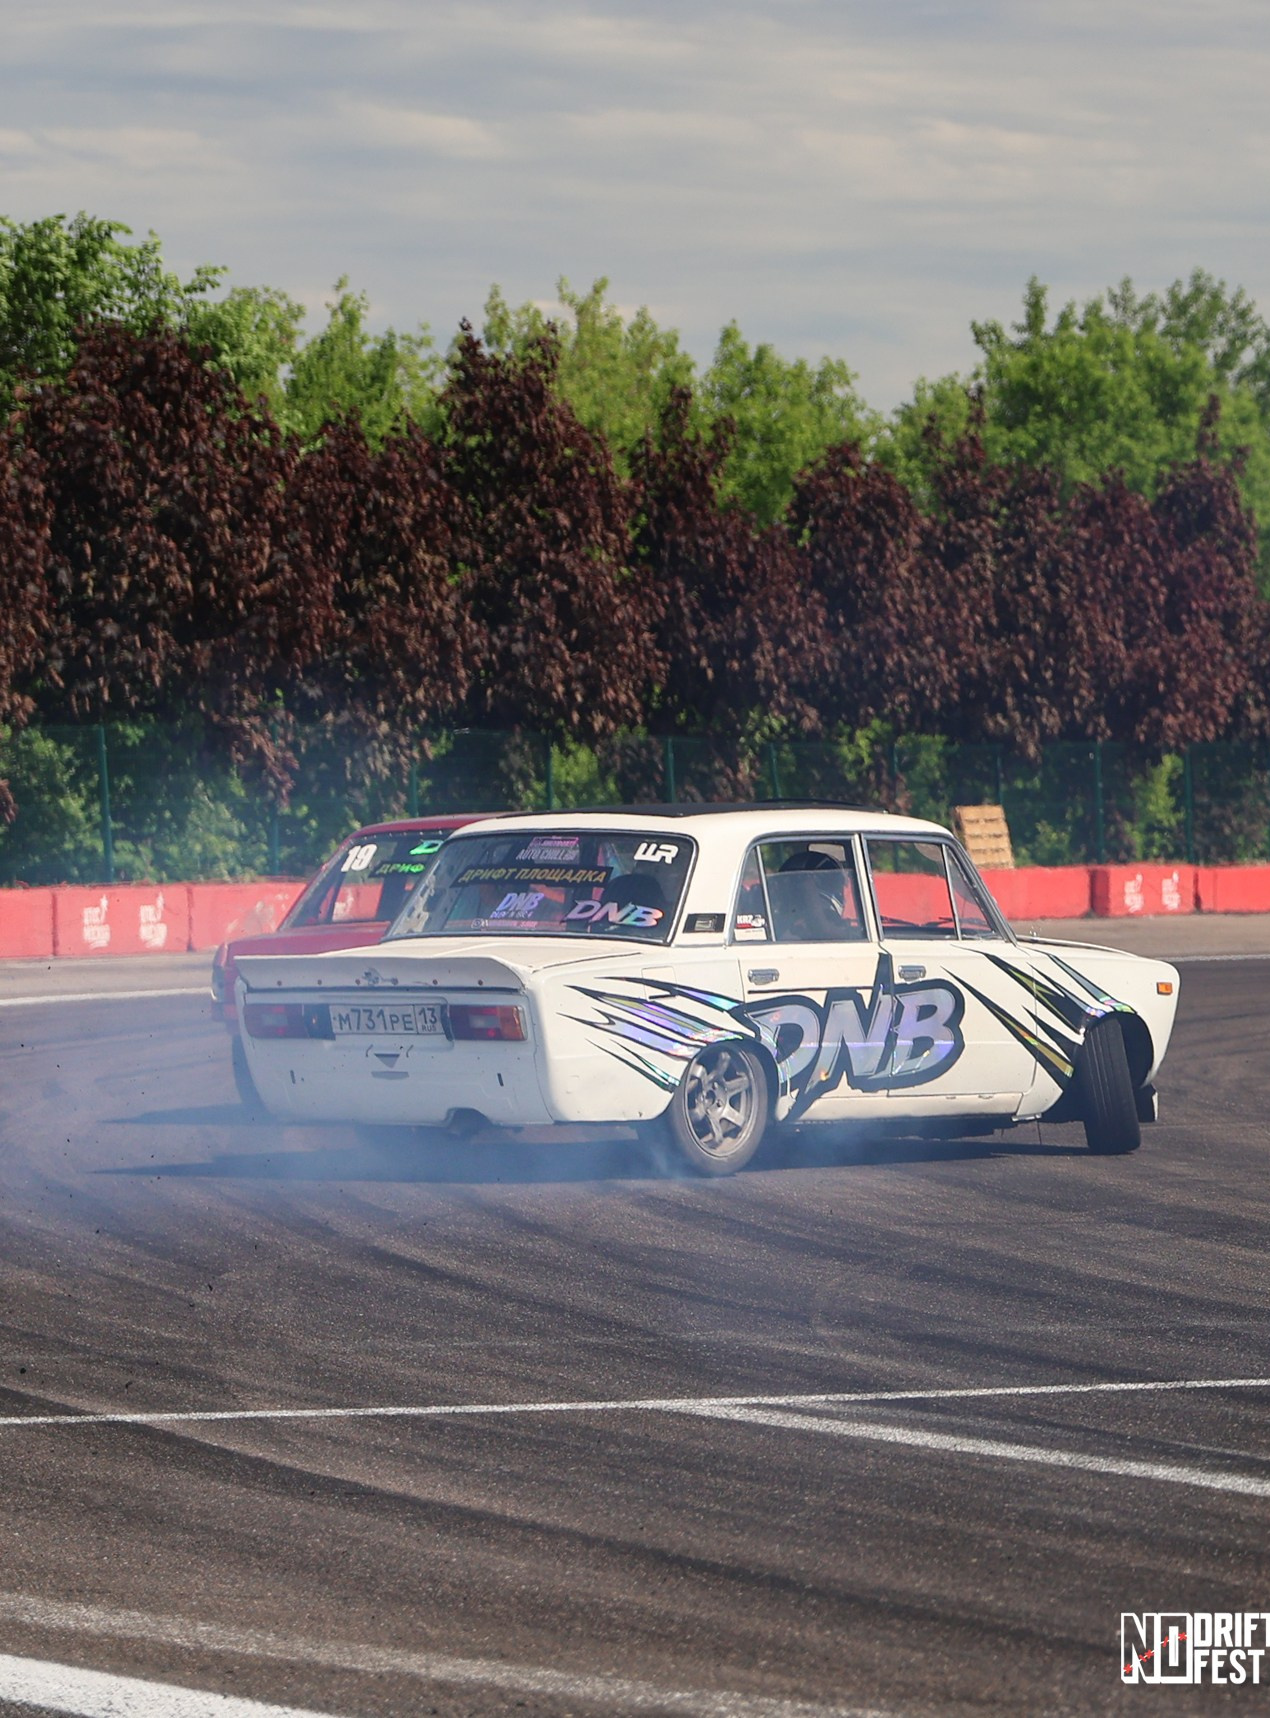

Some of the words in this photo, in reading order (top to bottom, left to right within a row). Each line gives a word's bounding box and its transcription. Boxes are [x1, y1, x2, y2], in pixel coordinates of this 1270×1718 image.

[341, 844, 377, 872] 19
[376, 863, 426, 875] ДРИФ
[458, 868, 517, 883] ДРИФТ
[514, 868, 607, 883] ПЛОЩАДКА
[496, 892, 545, 911] DNB
[562, 900, 664, 928] DNB
[418, 1007, 437, 1025] 13
[421, 1025, 437, 1033] RUS
[742, 980, 961, 1096] DNB
